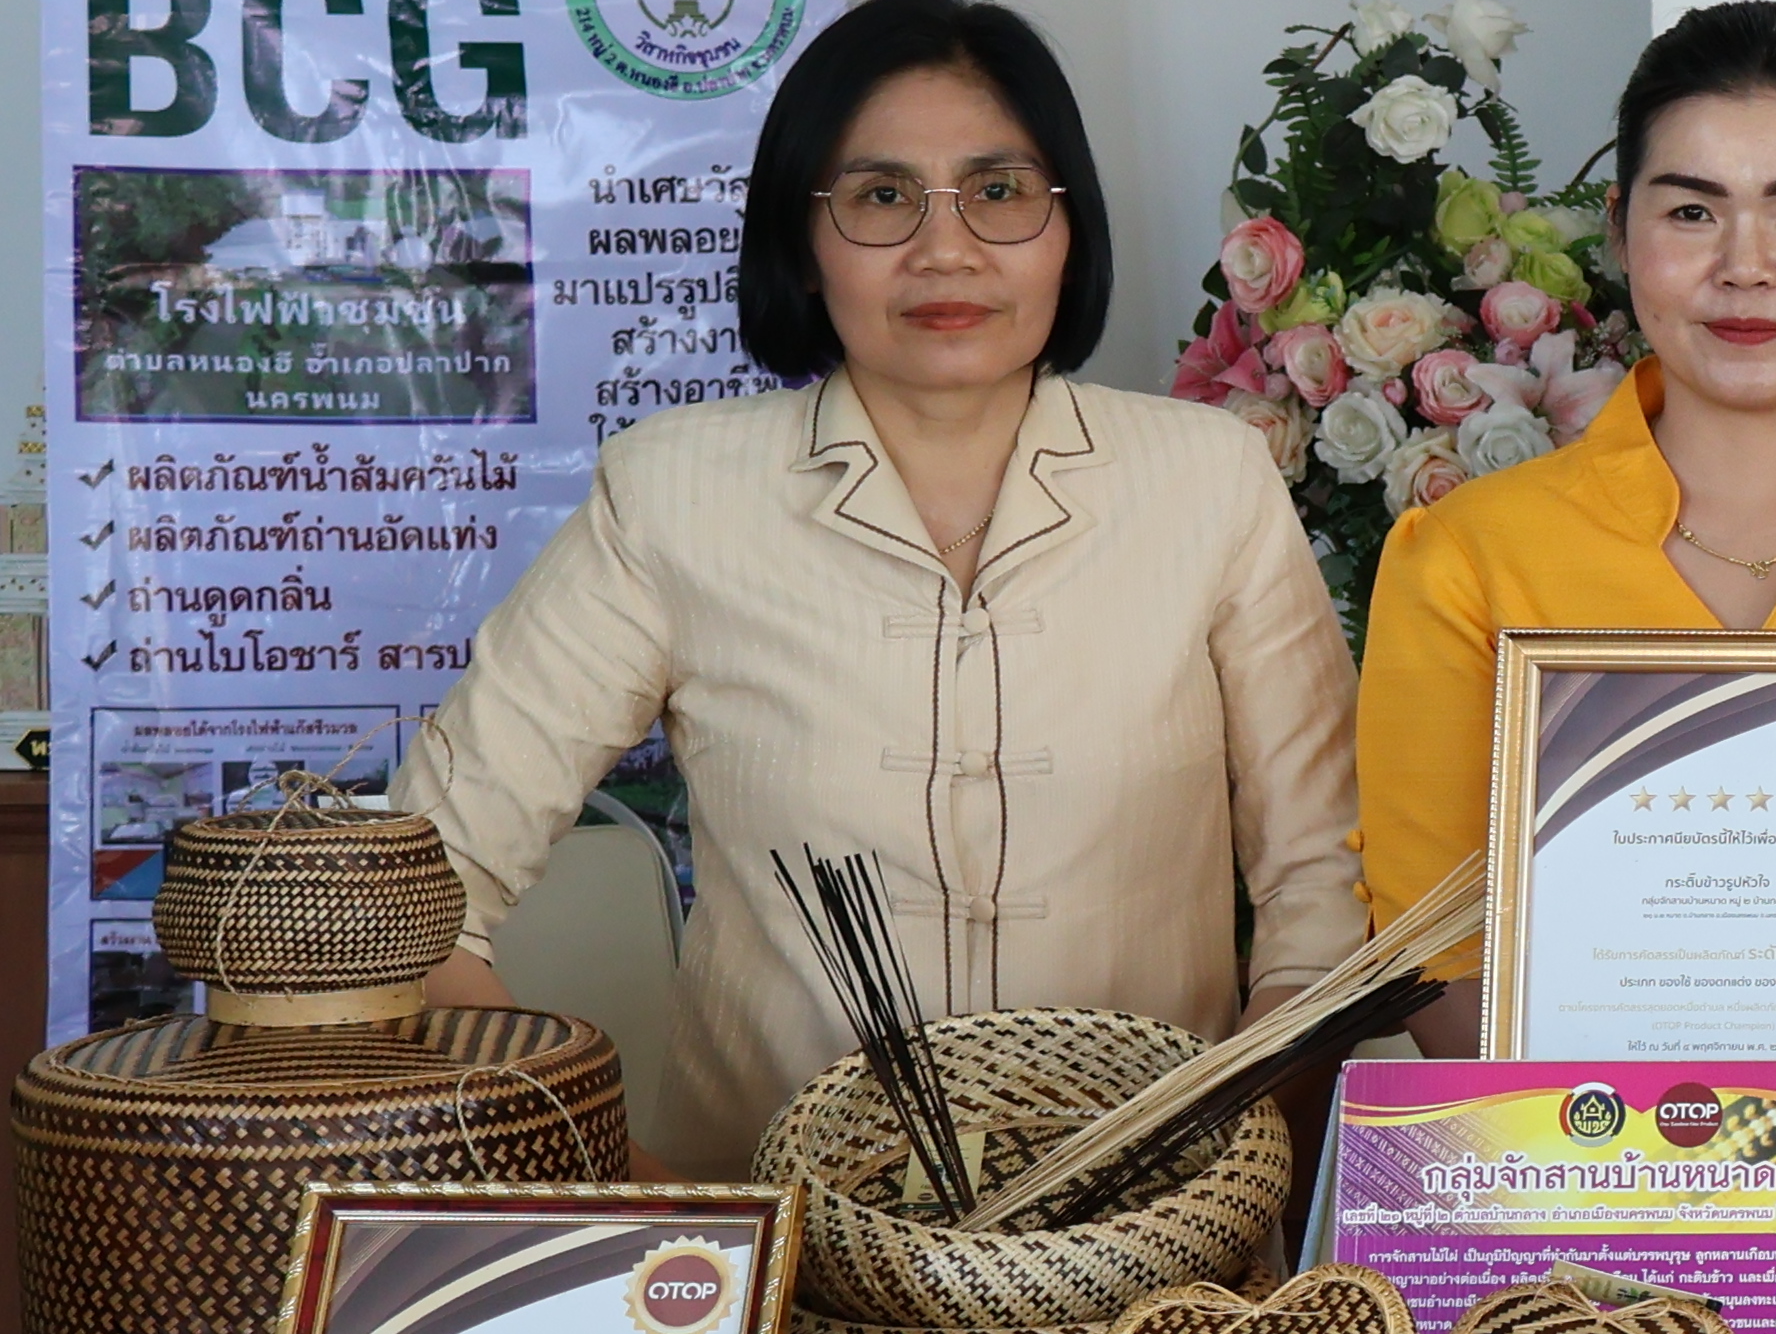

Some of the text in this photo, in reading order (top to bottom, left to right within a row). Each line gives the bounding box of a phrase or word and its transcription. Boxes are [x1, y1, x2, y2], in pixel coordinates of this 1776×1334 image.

[590, 166, 749, 209] นำเศษวัส
[588, 225, 739, 260] ผลพลอย
[153, 279, 467, 335] โรงไฟฟ้าชุมชน
[611, 317, 739, 357] สร้างงา
[305, 339, 511, 376] อำเภอปลาปาก
[246, 387, 381, 412] นครพนม
[127, 446, 518, 493] ผลิตภัณฑ์น้ำส้มควันไม้
[127, 512, 498, 553] ผลิตภัณฑ์ถ่านอัดแท่ง
[127, 567, 333, 629] ถ่านดูดกลิ่น
[127, 631, 472, 675] ถ่านไบโอชาร์ สารป
[1593, 948, 1745, 960] ได้รับการคัดสรรเป็นผลิตภัณฑ์
[1620, 977, 1656, 987] ประเภท
[1659, 974, 1691, 987] ของใช้
[1694, 976, 1752, 987] ของตกแต่ง
[1628, 1040, 1646, 1051] ให้ไว้
[1662, 1040, 1680, 1051] วันที่
[1692, 1042, 1744, 1052] พฤศจิกายน
[1660, 1103, 1719, 1119] OTOP
[1424, 1153, 1775, 1202] กลุ่มจักสานบ้านหนาด
[1345, 1204, 1378, 1223] เลขที่
[1404, 1206, 1433, 1227] หมู่ที่
[1437, 1209, 1449, 1222] ๒
[1454, 1206, 1547, 1223] ตำบลบ้านกลาง
[1552, 1204, 1673, 1222] อำเภอเมืองนครพนม
[1678, 1203, 1773, 1220] จังหวัดนครพนม
[1368, 1247, 1459, 1264] การจักสานไม้ไผ่
[1463, 1244, 1691, 1267] เป็นภูมิปัญญาที่ทำกันมาตั้งแต่บรรพบุรุษ
[648, 1280, 717, 1301] OTOP
[1642, 1271, 1675, 1285] ได้แก่
